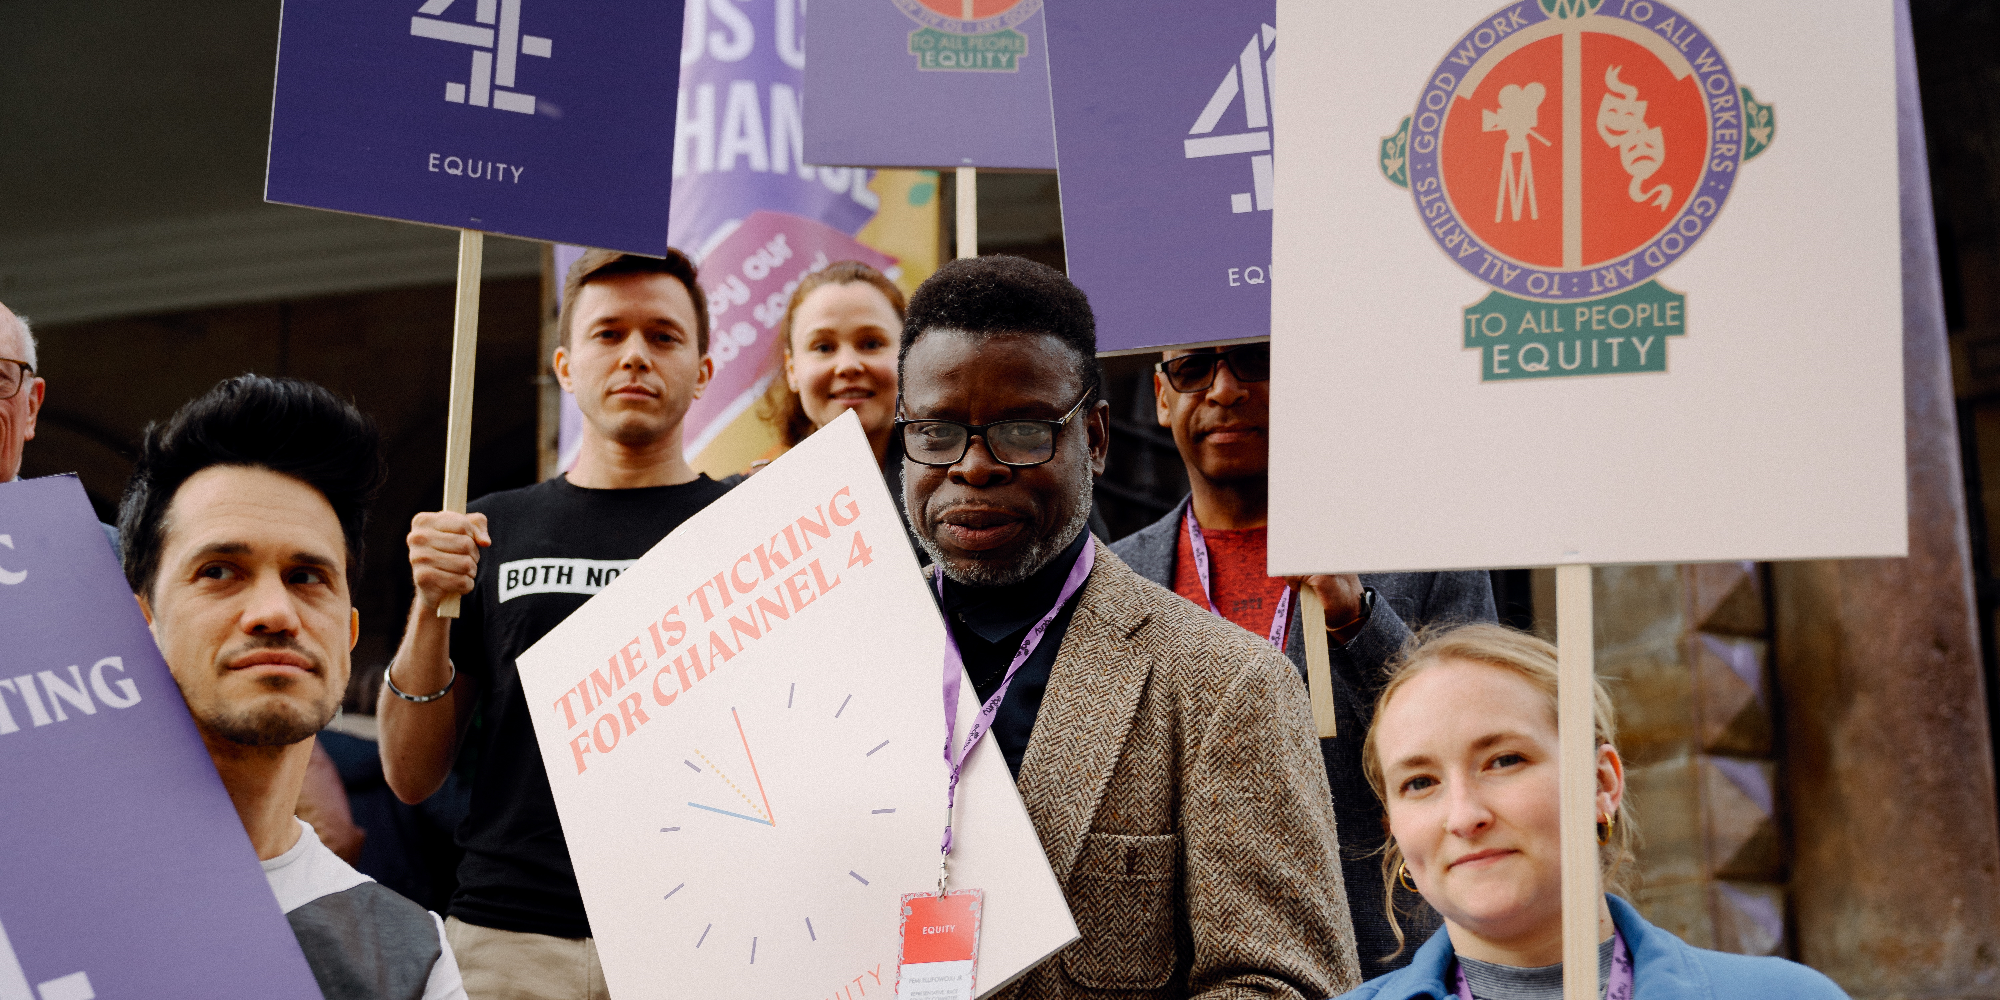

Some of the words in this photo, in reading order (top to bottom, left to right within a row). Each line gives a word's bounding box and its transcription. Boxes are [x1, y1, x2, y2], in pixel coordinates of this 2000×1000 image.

[1619, 0, 1653, 22] TO
[1654, 16, 1698, 53] ALL
[925, 51, 1012, 67] EQUITY
[1414, 72, 1455, 154] GOOD
[1450, 6, 1529, 67] WORK
[1693, 46, 1737, 173] WORKERS
[428, 153, 525, 184] EQUITY
[1416, 176, 1480, 259] ARTISTS
[1644, 195, 1717, 268] GOOD
[1228, 264, 1273, 287] EQ
[1477, 252, 1523, 285] ALL
[1526, 273, 1563, 296] TO
[1590, 259, 1635, 292] ART
[1466, 312, 1507, 337] TO
[1517, 309, 1564, 335] ALL
[1575, 301, 1681, 332] PEOPLE
[1492, 335, 1656, 374] EQUITY
[506, 566, 573, 591] BOTH
[586, 567, 631, 588] NO
[553, 636, 649, 731] TIME
[647, 605, 687, 660] IS
[686, 485, 861, 623] TICKING
[568, 691, 651, 776] FOR
[652, 558, 841, 707] CHANNEL
[846, 530, 874, 570] 4
[922, 924, 956, 935] EQUITY
